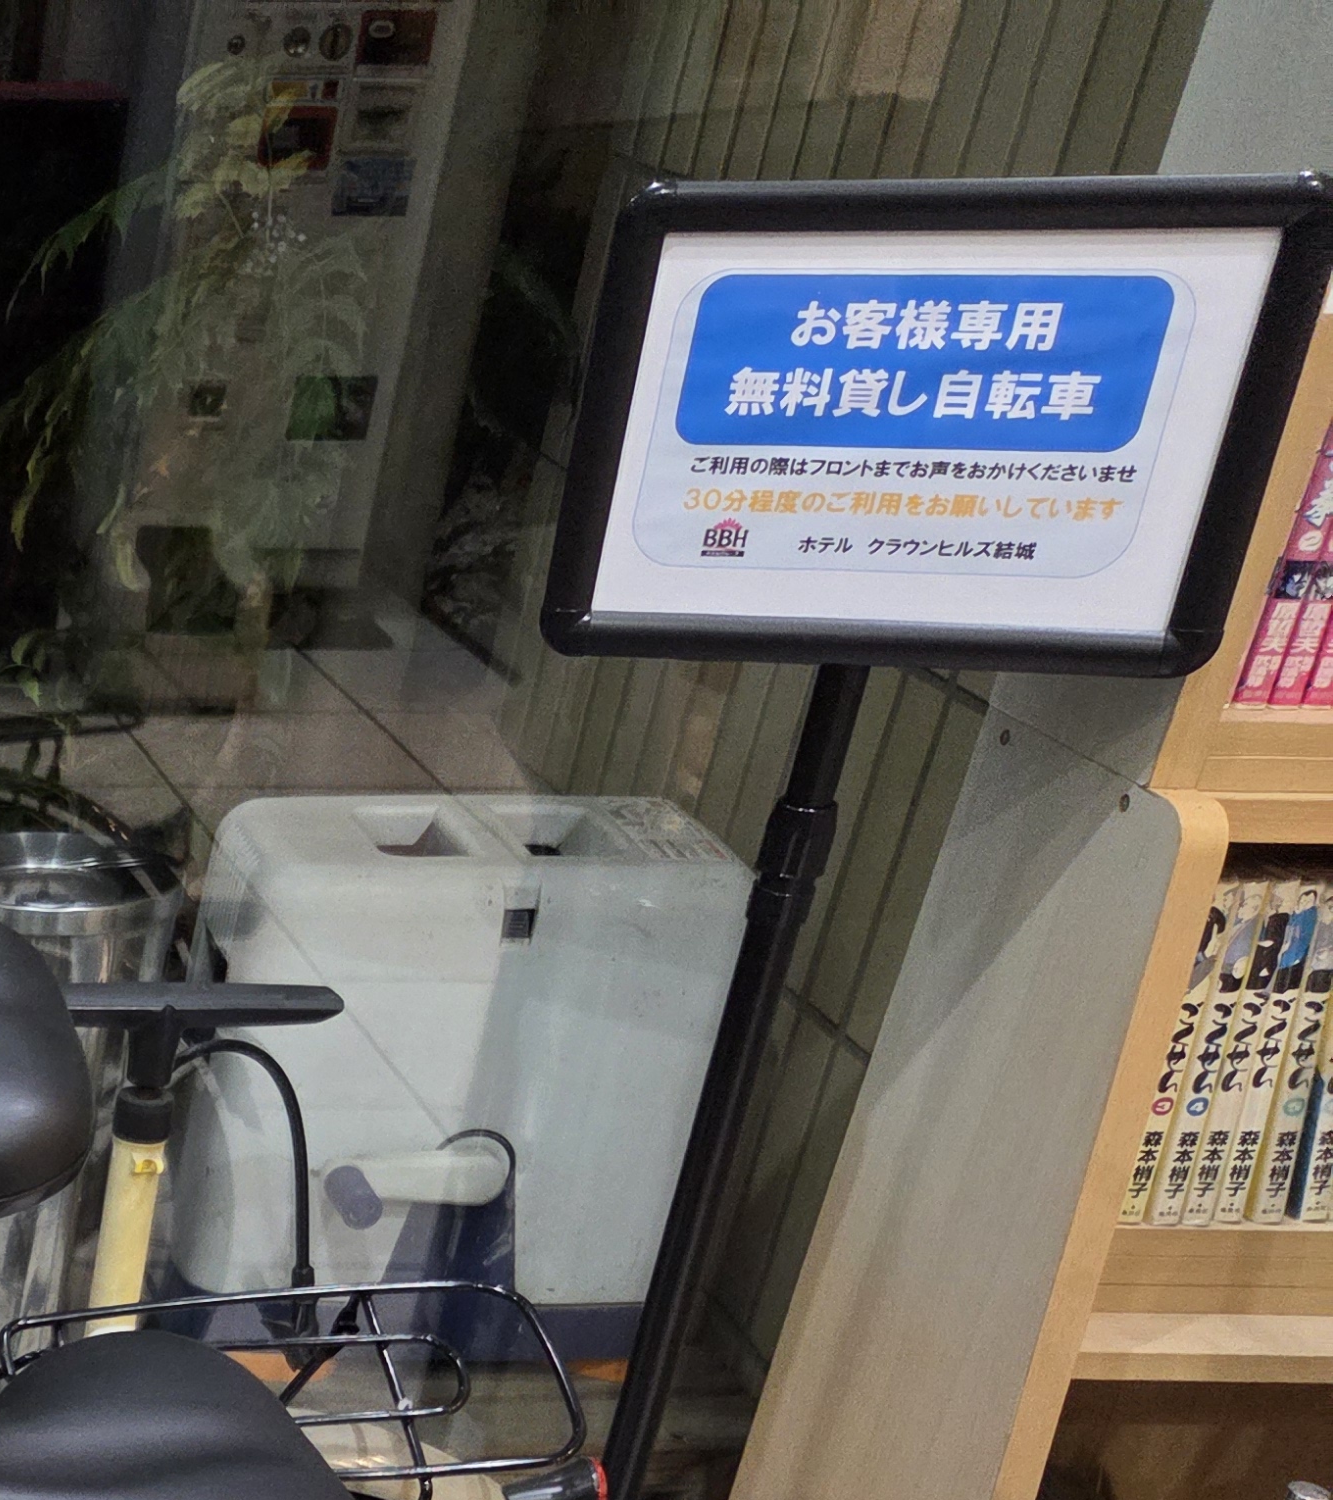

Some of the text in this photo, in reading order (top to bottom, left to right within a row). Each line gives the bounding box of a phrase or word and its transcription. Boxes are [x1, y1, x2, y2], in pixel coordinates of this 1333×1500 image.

[790, 298, 1065, 350] お客様専用
[724, 365, 1102, 420] 無料貸し自転車
[689, 454, 1138, 483] ご利用の際はフロントまでお声をおかけくださいませ
[683, 487, 1123, 521] 30分程度のご利用をお願いしています
[702, 528, 749, 548] BBH
[798, 536, 1038, 560] ホテル クラウンヒルズ結城
